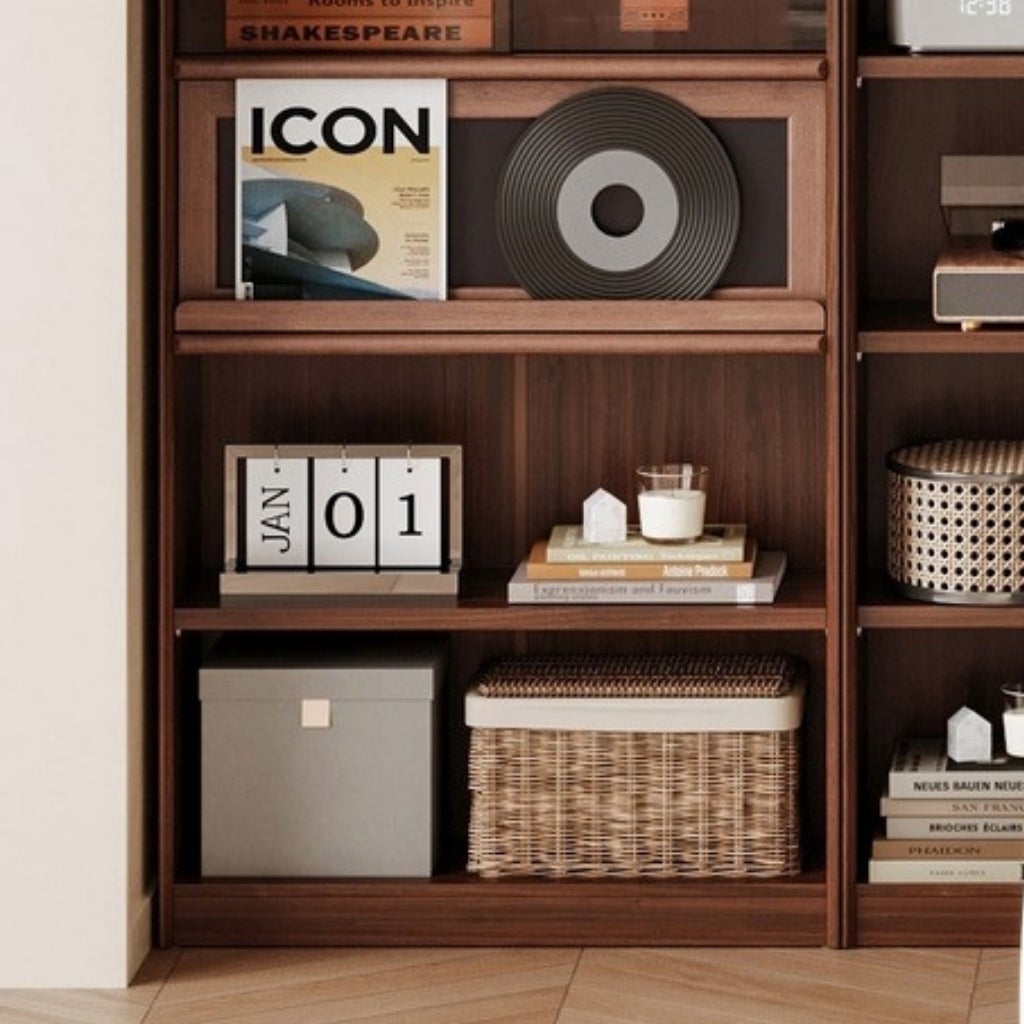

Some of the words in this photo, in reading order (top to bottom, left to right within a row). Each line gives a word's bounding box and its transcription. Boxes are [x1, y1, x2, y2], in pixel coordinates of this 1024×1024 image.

[240, 25, 462, 41] SHAKESPEARE
[251, 106, 430, 155] ICON
[260, 486, 290, 554] JAN
[533, 583, 627, 595] Expressionism
[632, 583, 654, 594] and
[913, 781, 950, 792] NEUES
[952, 781, 991, 792] BAUEN
[951, 803, 978, 812] SAN
[929, 824, 978, 833] BRIOCHES
[983, 822, 1022, 833] ÉCLAIRS
[908, 846, 980, 856] PHAIDON
